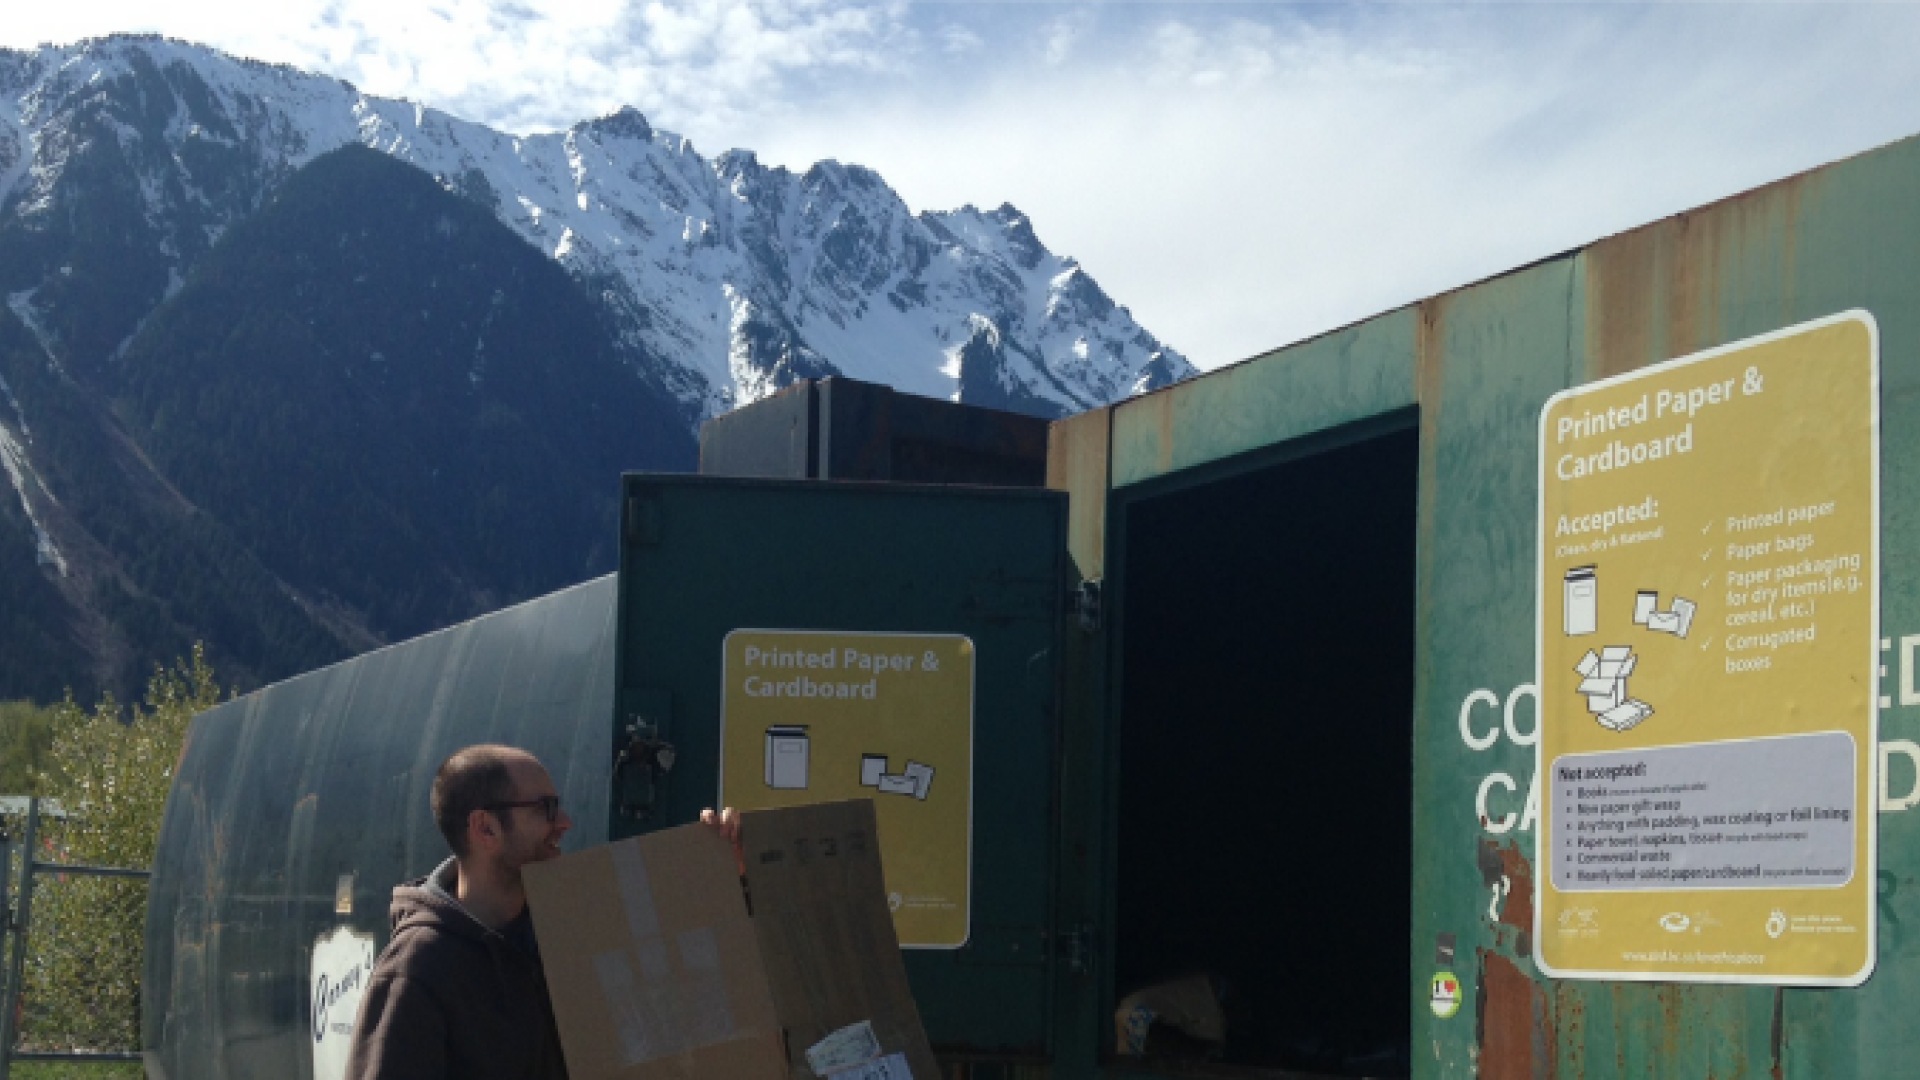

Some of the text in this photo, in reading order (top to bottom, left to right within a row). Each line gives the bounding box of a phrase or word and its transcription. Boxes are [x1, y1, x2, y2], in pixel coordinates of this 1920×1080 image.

[1557, 366, 1764, 443] Printed Paper &
[1557, 423, 1693, 480] Cardboard
[1556, 496, 1659, 536] Accepted:
[1726, 500, 1835, 533] Printed paper
[1726, 533, 1814, 560] Paper bags
[1726, 553, 1861, 588] Paper packaging
[1726, 590, 1748, 607] for
[1752, 584, 1778, 605] dry
[1725, 623, 1817, 651] Corrugated
[744, 645, 940, 674] Printed Paper &
[1725, 656, 1772, 674] boxes
[744, 676, 877, 700] Cardboard
[1558, 762, 1647, 782] Not accepted:
[1577, 818, 1624, 833] Anything
[1626, 816, 1650, 830] with
[1728, 811, 1772, 827] coating
[1775, 812, 1788, 822] or
[1814, 807, 1850, 822] lining
[1601, 802, 1629, 816] paper
[1577, 835, 1605, 850] Paper
